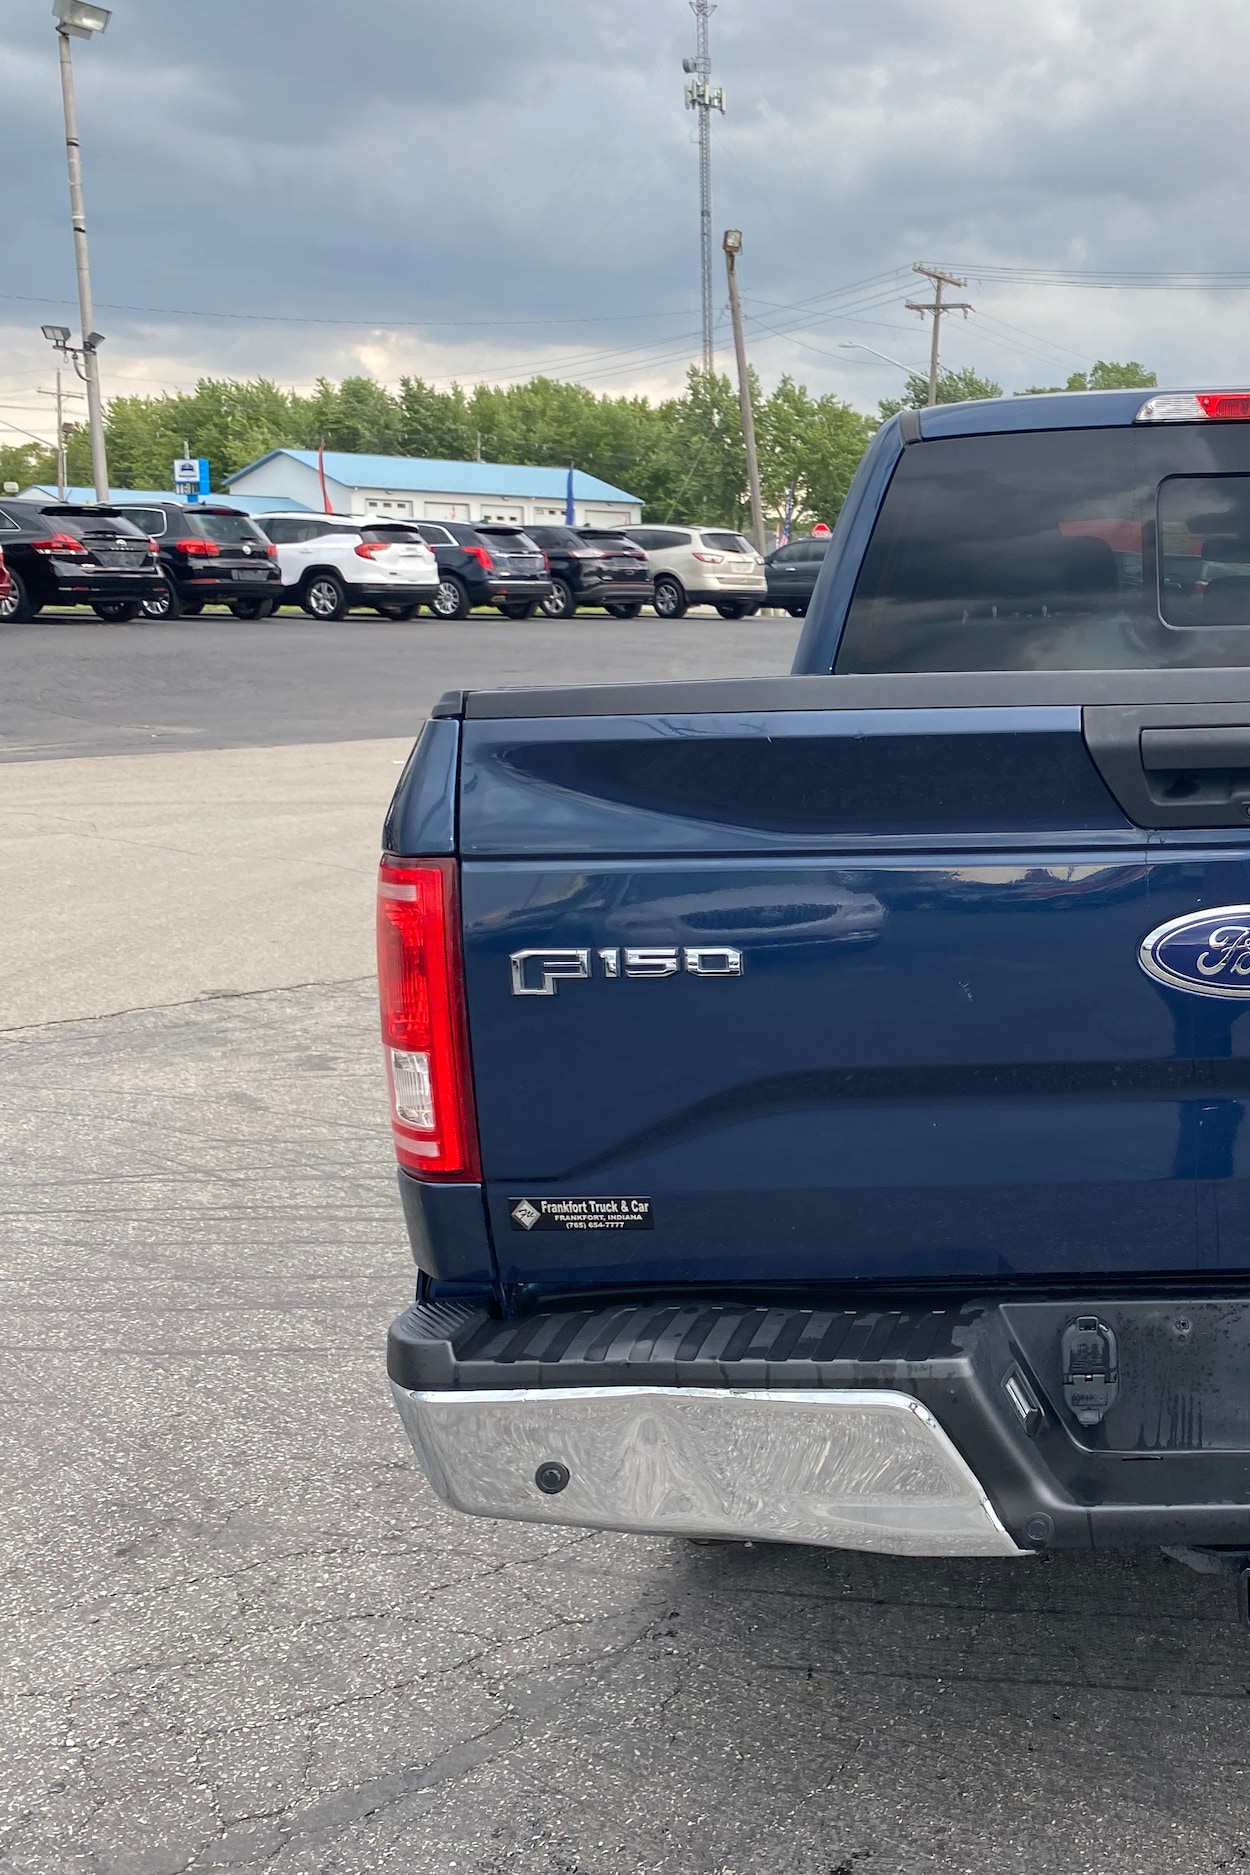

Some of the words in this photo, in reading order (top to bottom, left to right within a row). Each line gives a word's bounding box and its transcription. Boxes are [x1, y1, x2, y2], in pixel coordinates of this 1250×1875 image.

[541, 1200, 588, 1214] Frankfort
[588, 1200, 619, 1213] Truck
[620, 1200, 630, 1213] &
[630, 1200, 650, 1213] Car
[566, 1222, 587, 1230] (765)
[588, 1221, 625, 1229] 654-7777
